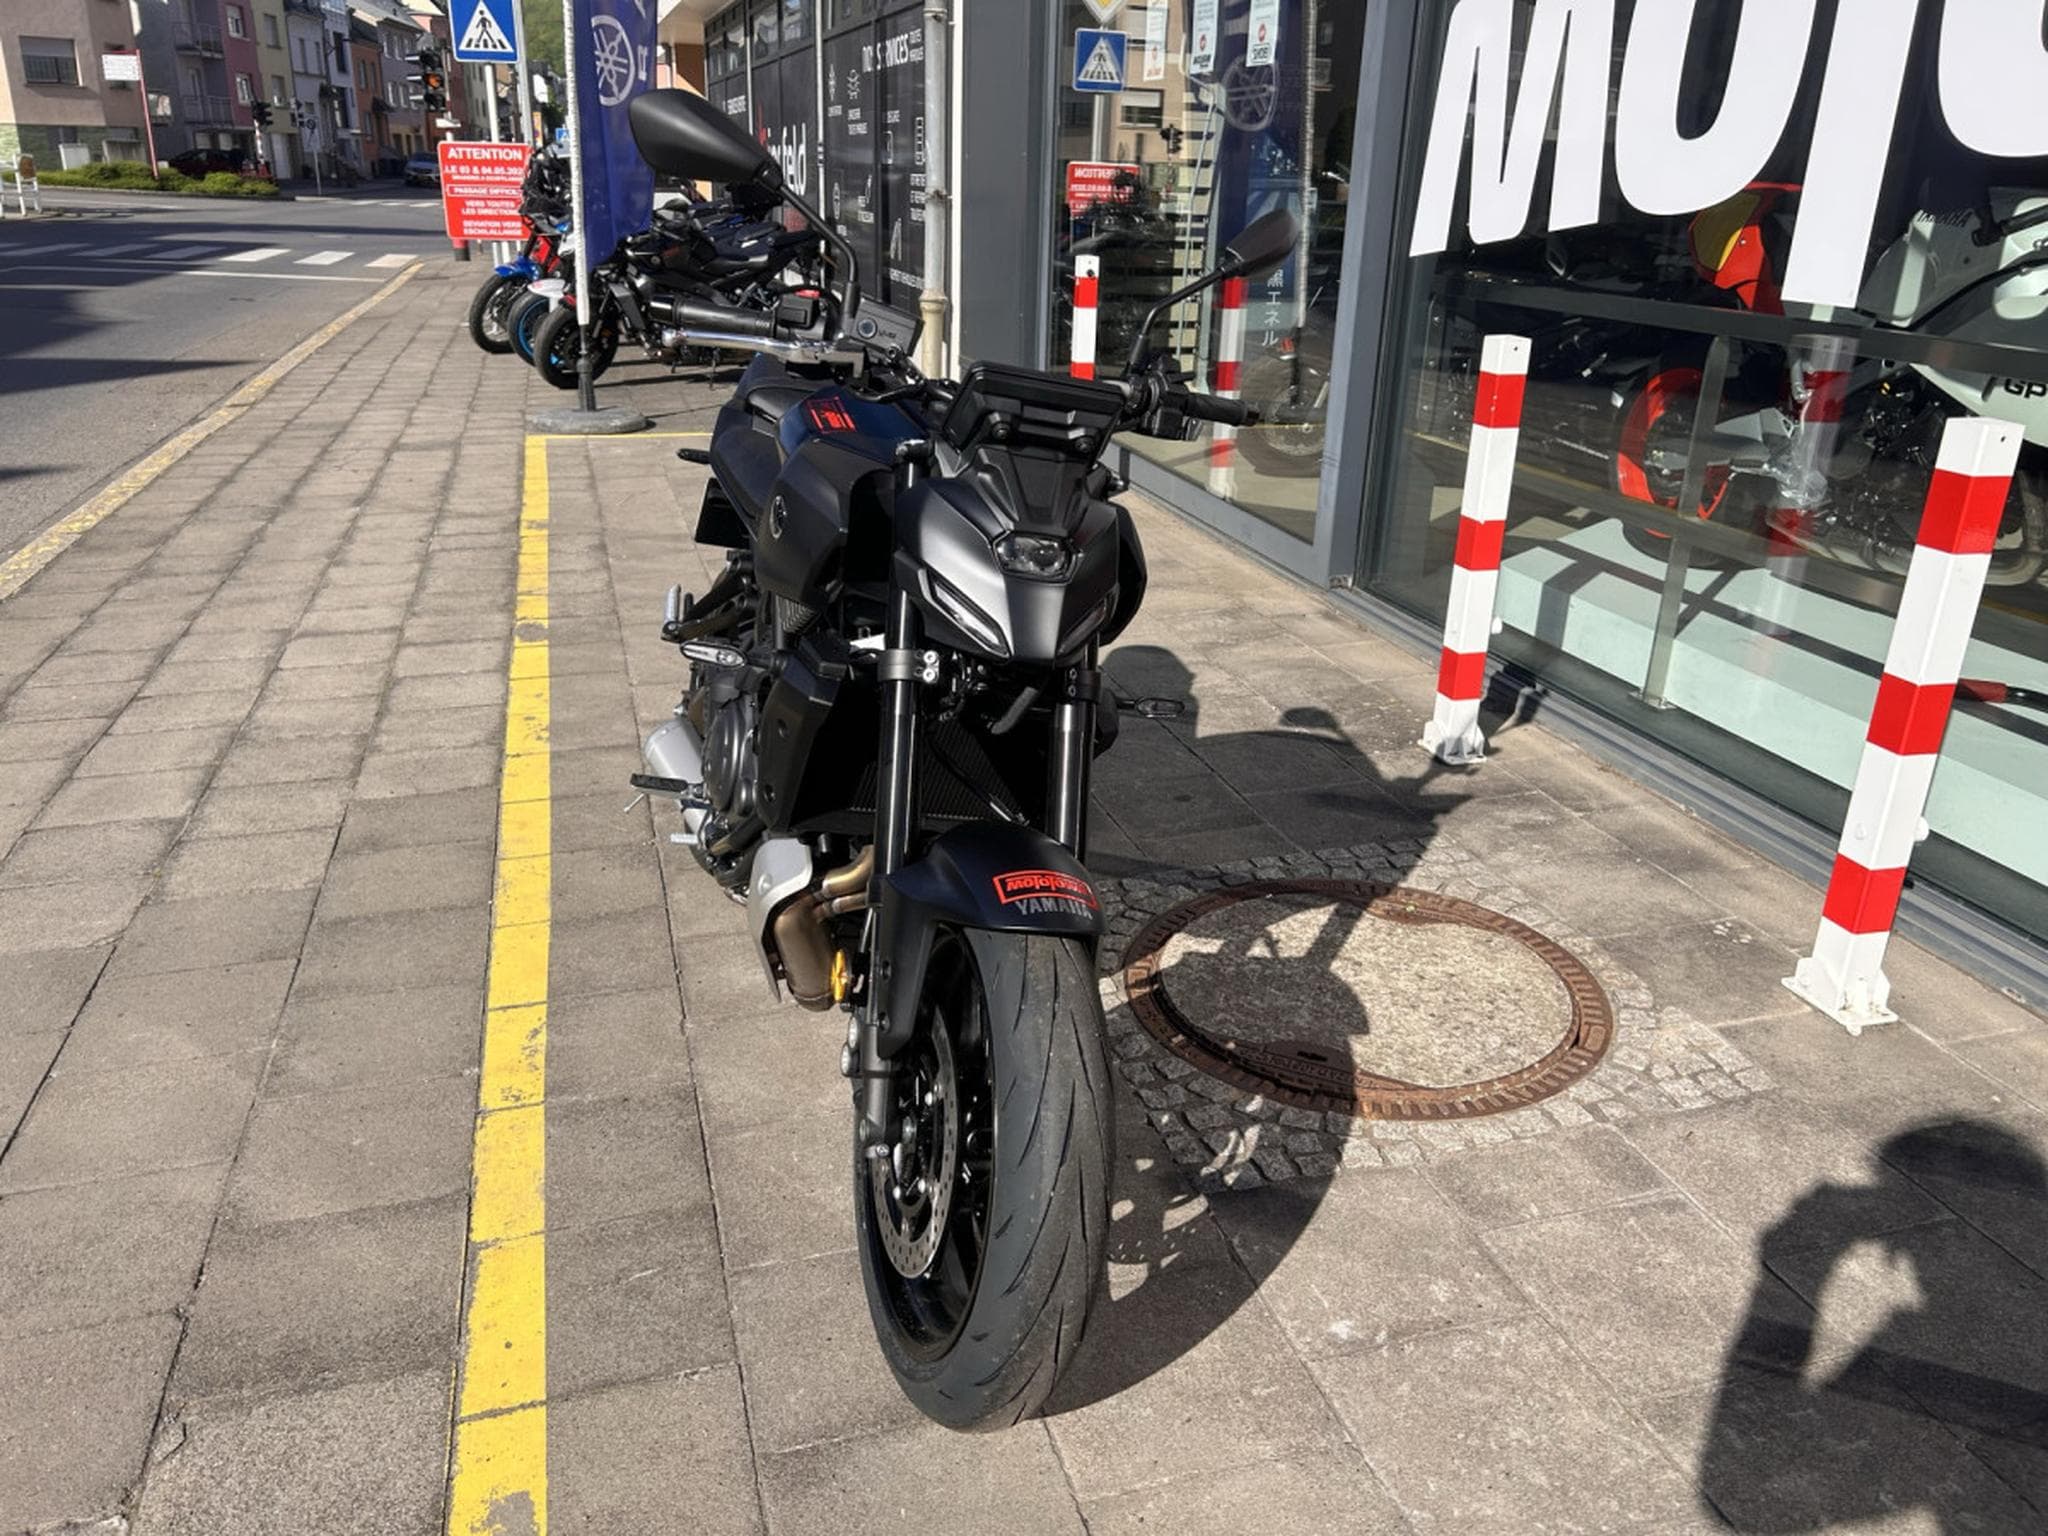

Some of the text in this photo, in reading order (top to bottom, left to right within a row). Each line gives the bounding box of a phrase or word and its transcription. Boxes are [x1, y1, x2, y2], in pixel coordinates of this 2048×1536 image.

[876, 34, 908, 71] SRVICES
[447, 147, 523, 160] ATTENTION
[1015, 897, 1093, 920] YAMAHA
